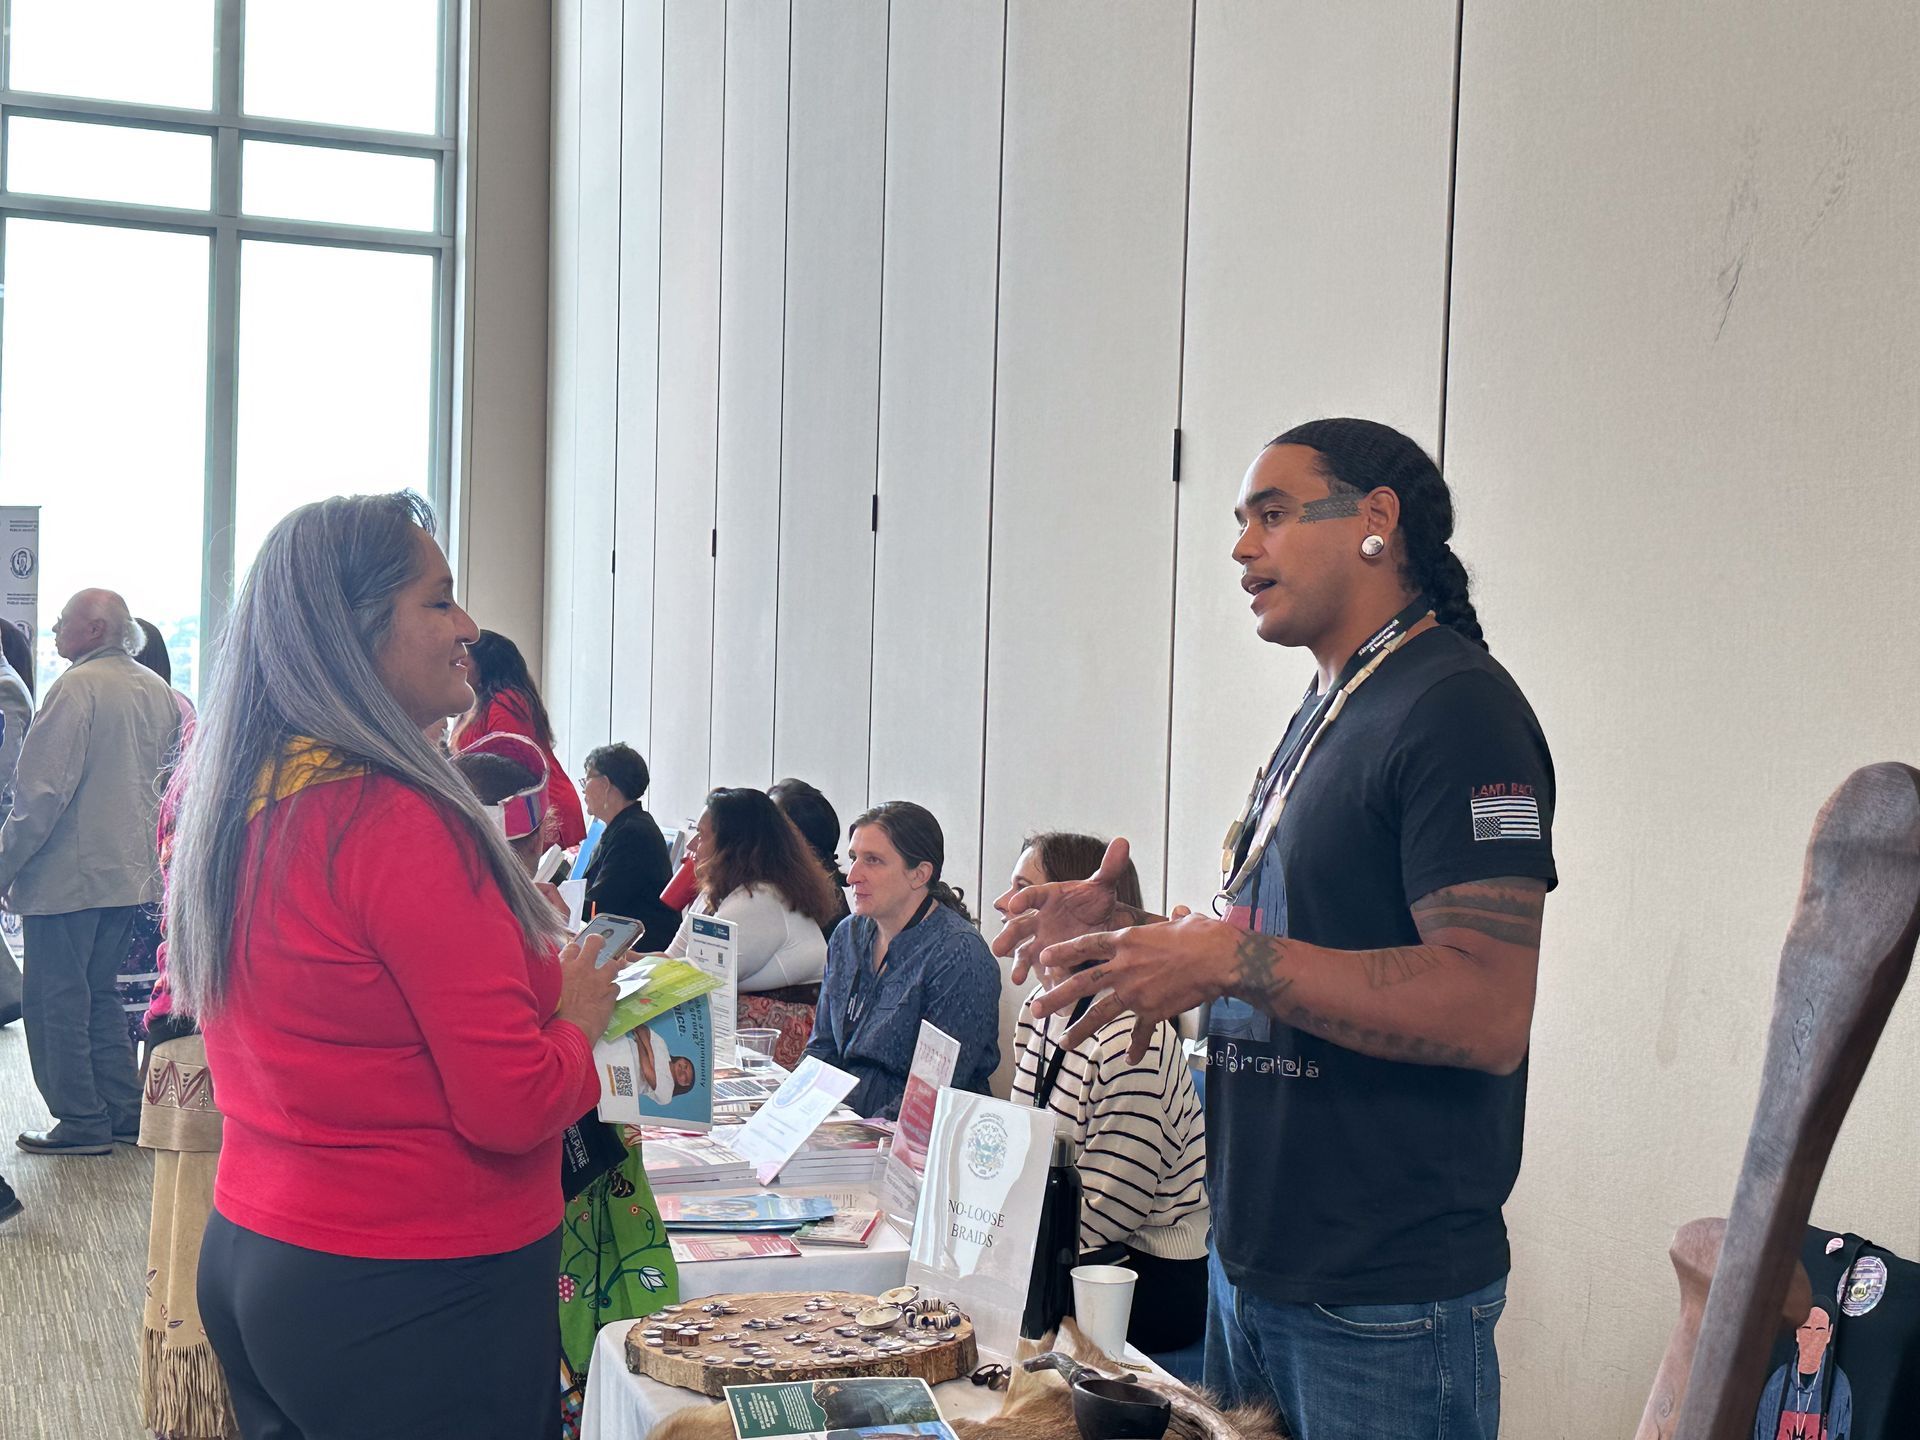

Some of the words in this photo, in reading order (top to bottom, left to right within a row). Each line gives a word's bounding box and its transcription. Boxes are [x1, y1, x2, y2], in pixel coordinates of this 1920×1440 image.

[1471, 783, 1505, 799] LAND
[948, 1199, 1005, 1228] NO-LOOSE
[951, 1223, 994, 1248] BRAIDS
